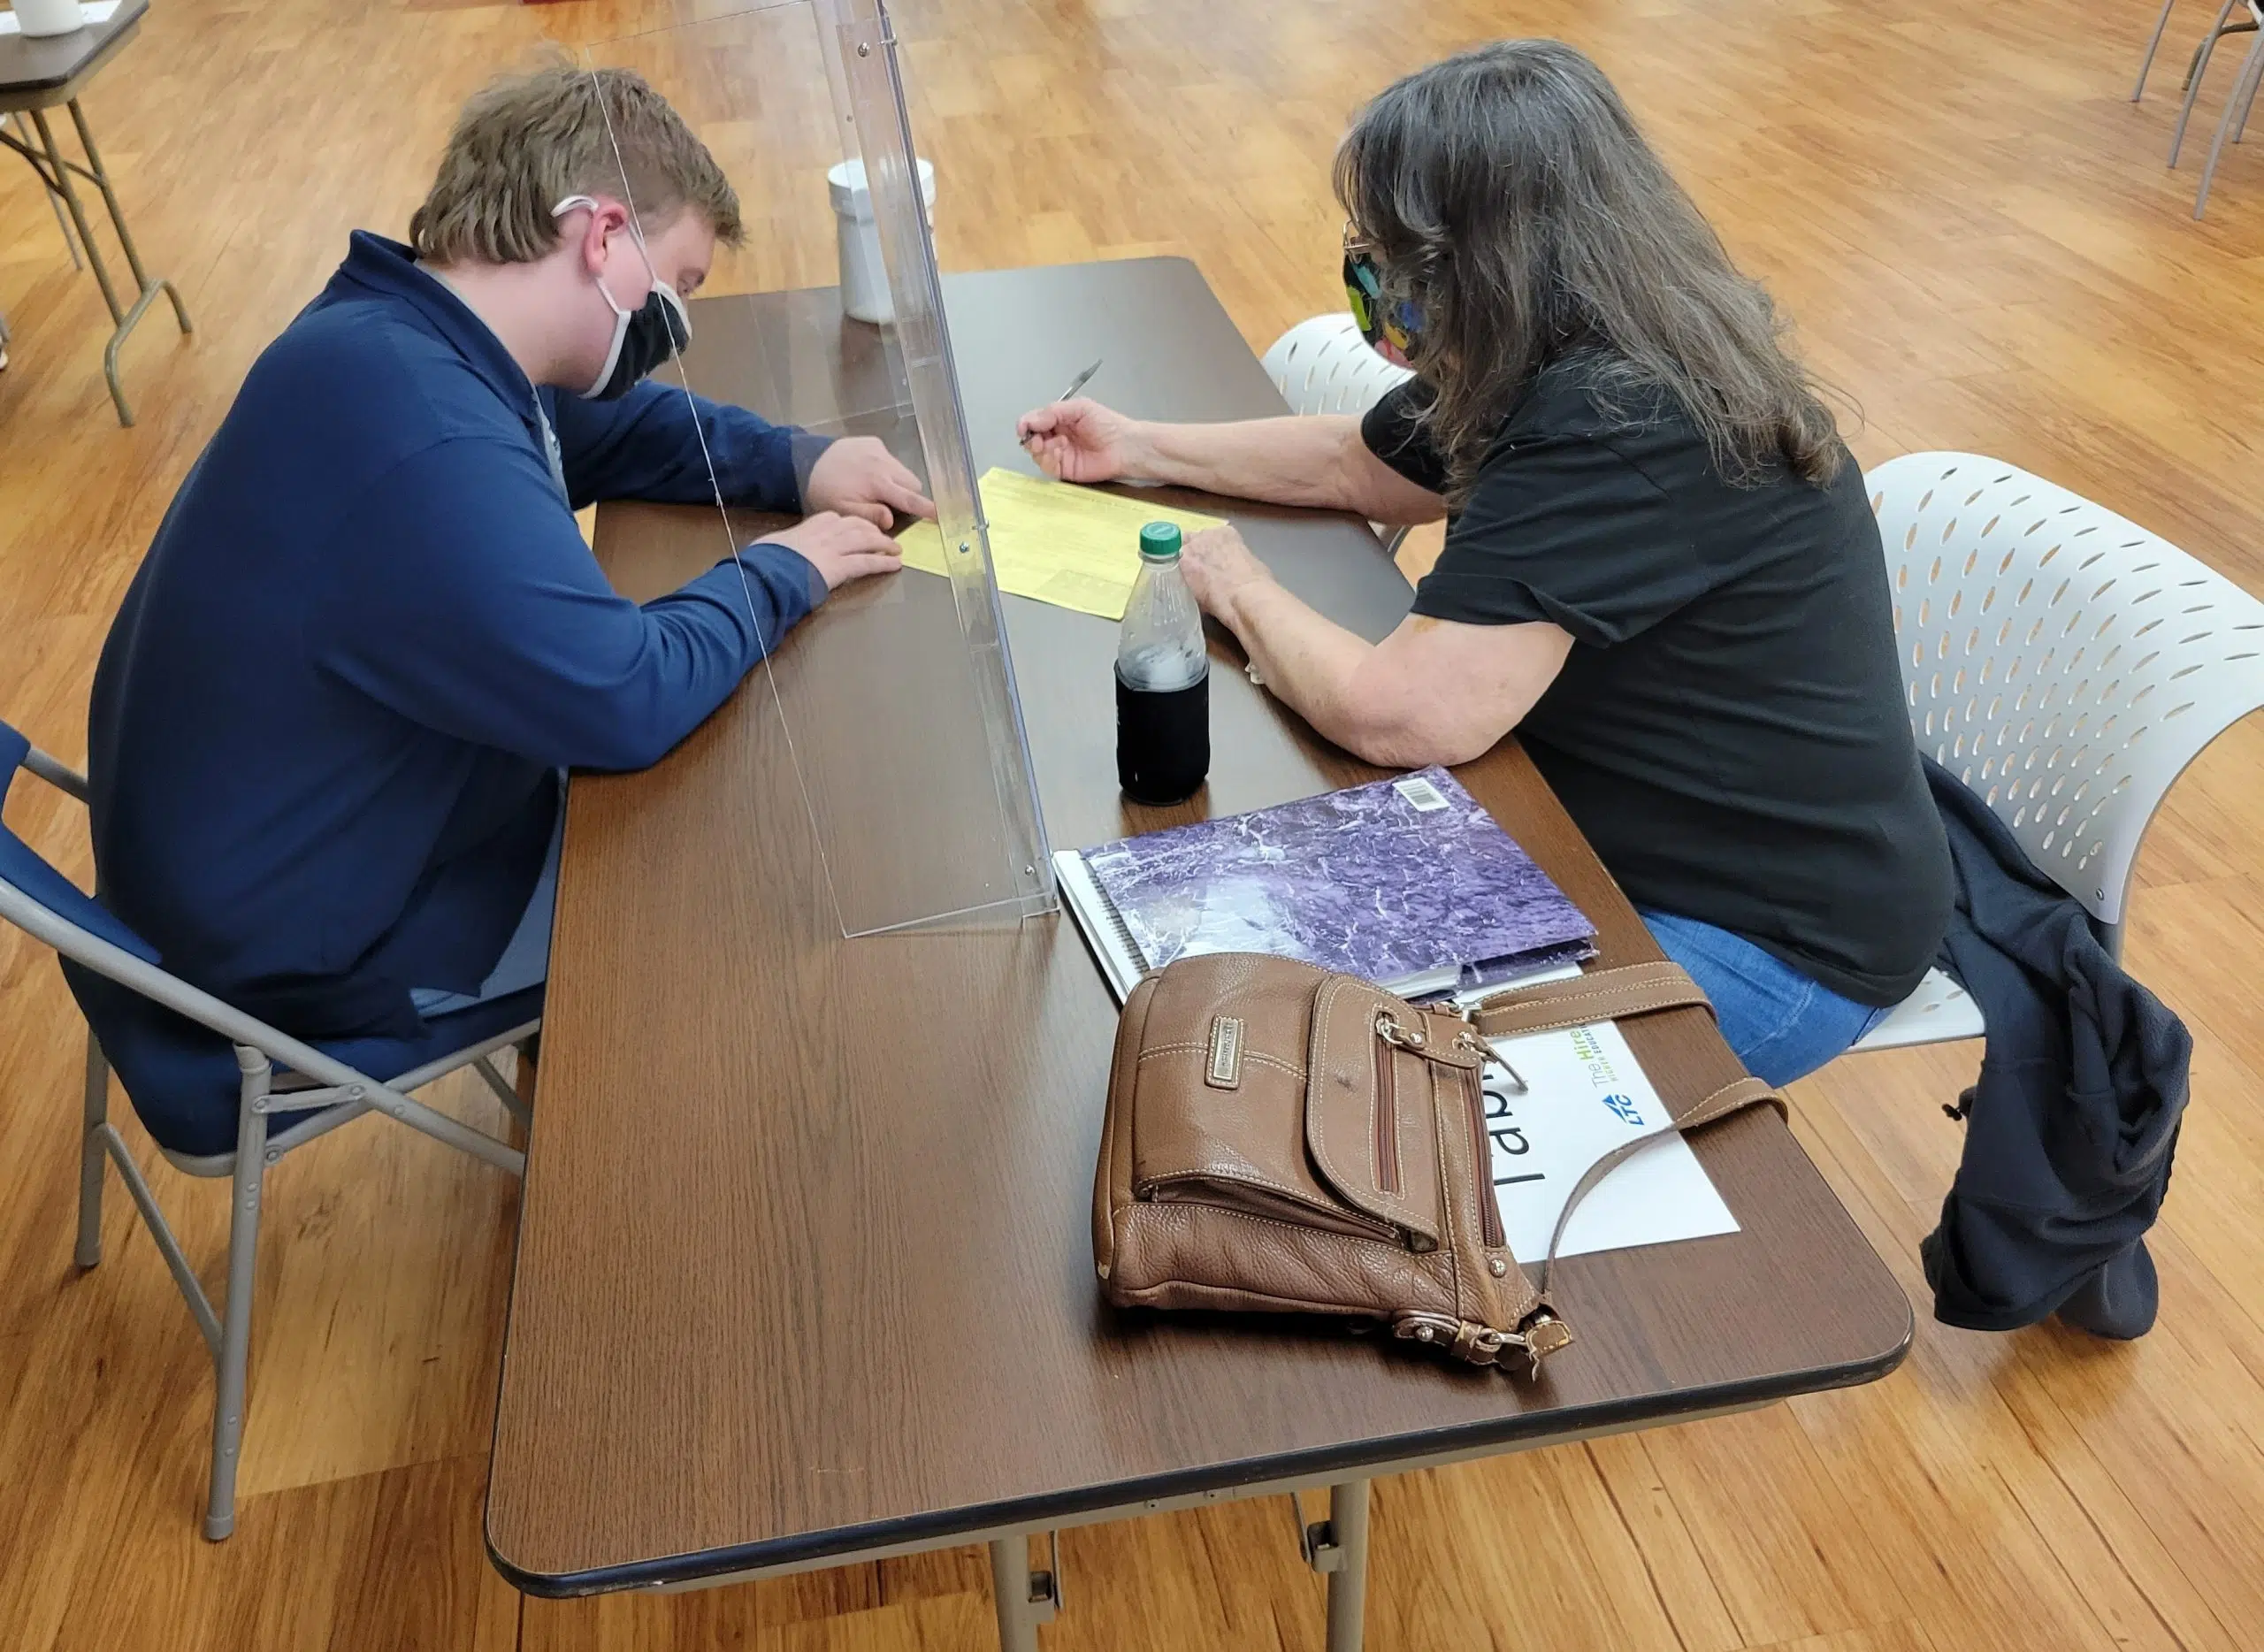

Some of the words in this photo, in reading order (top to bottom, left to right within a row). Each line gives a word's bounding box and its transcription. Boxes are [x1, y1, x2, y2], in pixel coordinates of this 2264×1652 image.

[1571, 1031, 1594, 1059] Hire
[1588, 1063, 1610, 1089] The
[1615, 1094, 1644, 1126] LTC
